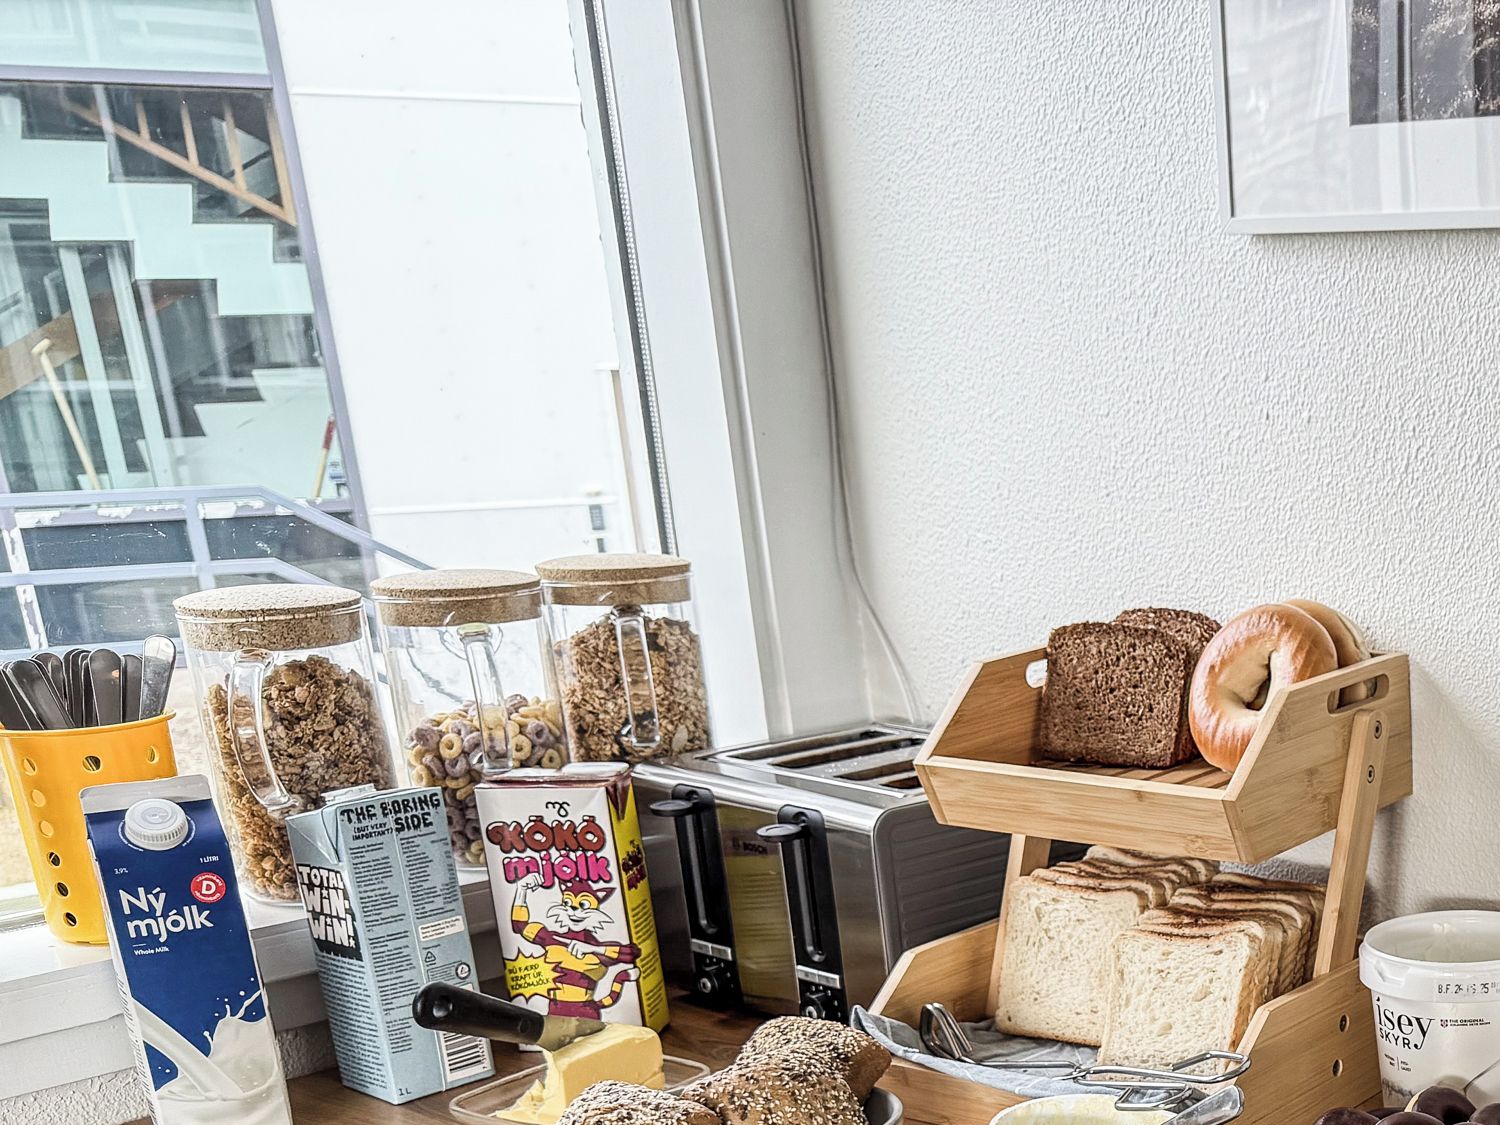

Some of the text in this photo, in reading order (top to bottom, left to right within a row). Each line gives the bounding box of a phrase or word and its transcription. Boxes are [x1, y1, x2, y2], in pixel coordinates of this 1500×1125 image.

[340, 792, 441, 824] THE BORING
[394, 812, 434, 833] SIDE
[201, 880, 216, 895] D
[298, 866, 345, 889] TOTAL
[119, 887, 166, 917] Ný
[127, 904, 214, 943] mjólk
[1379, 1028, 1411, 1050] SKYR
